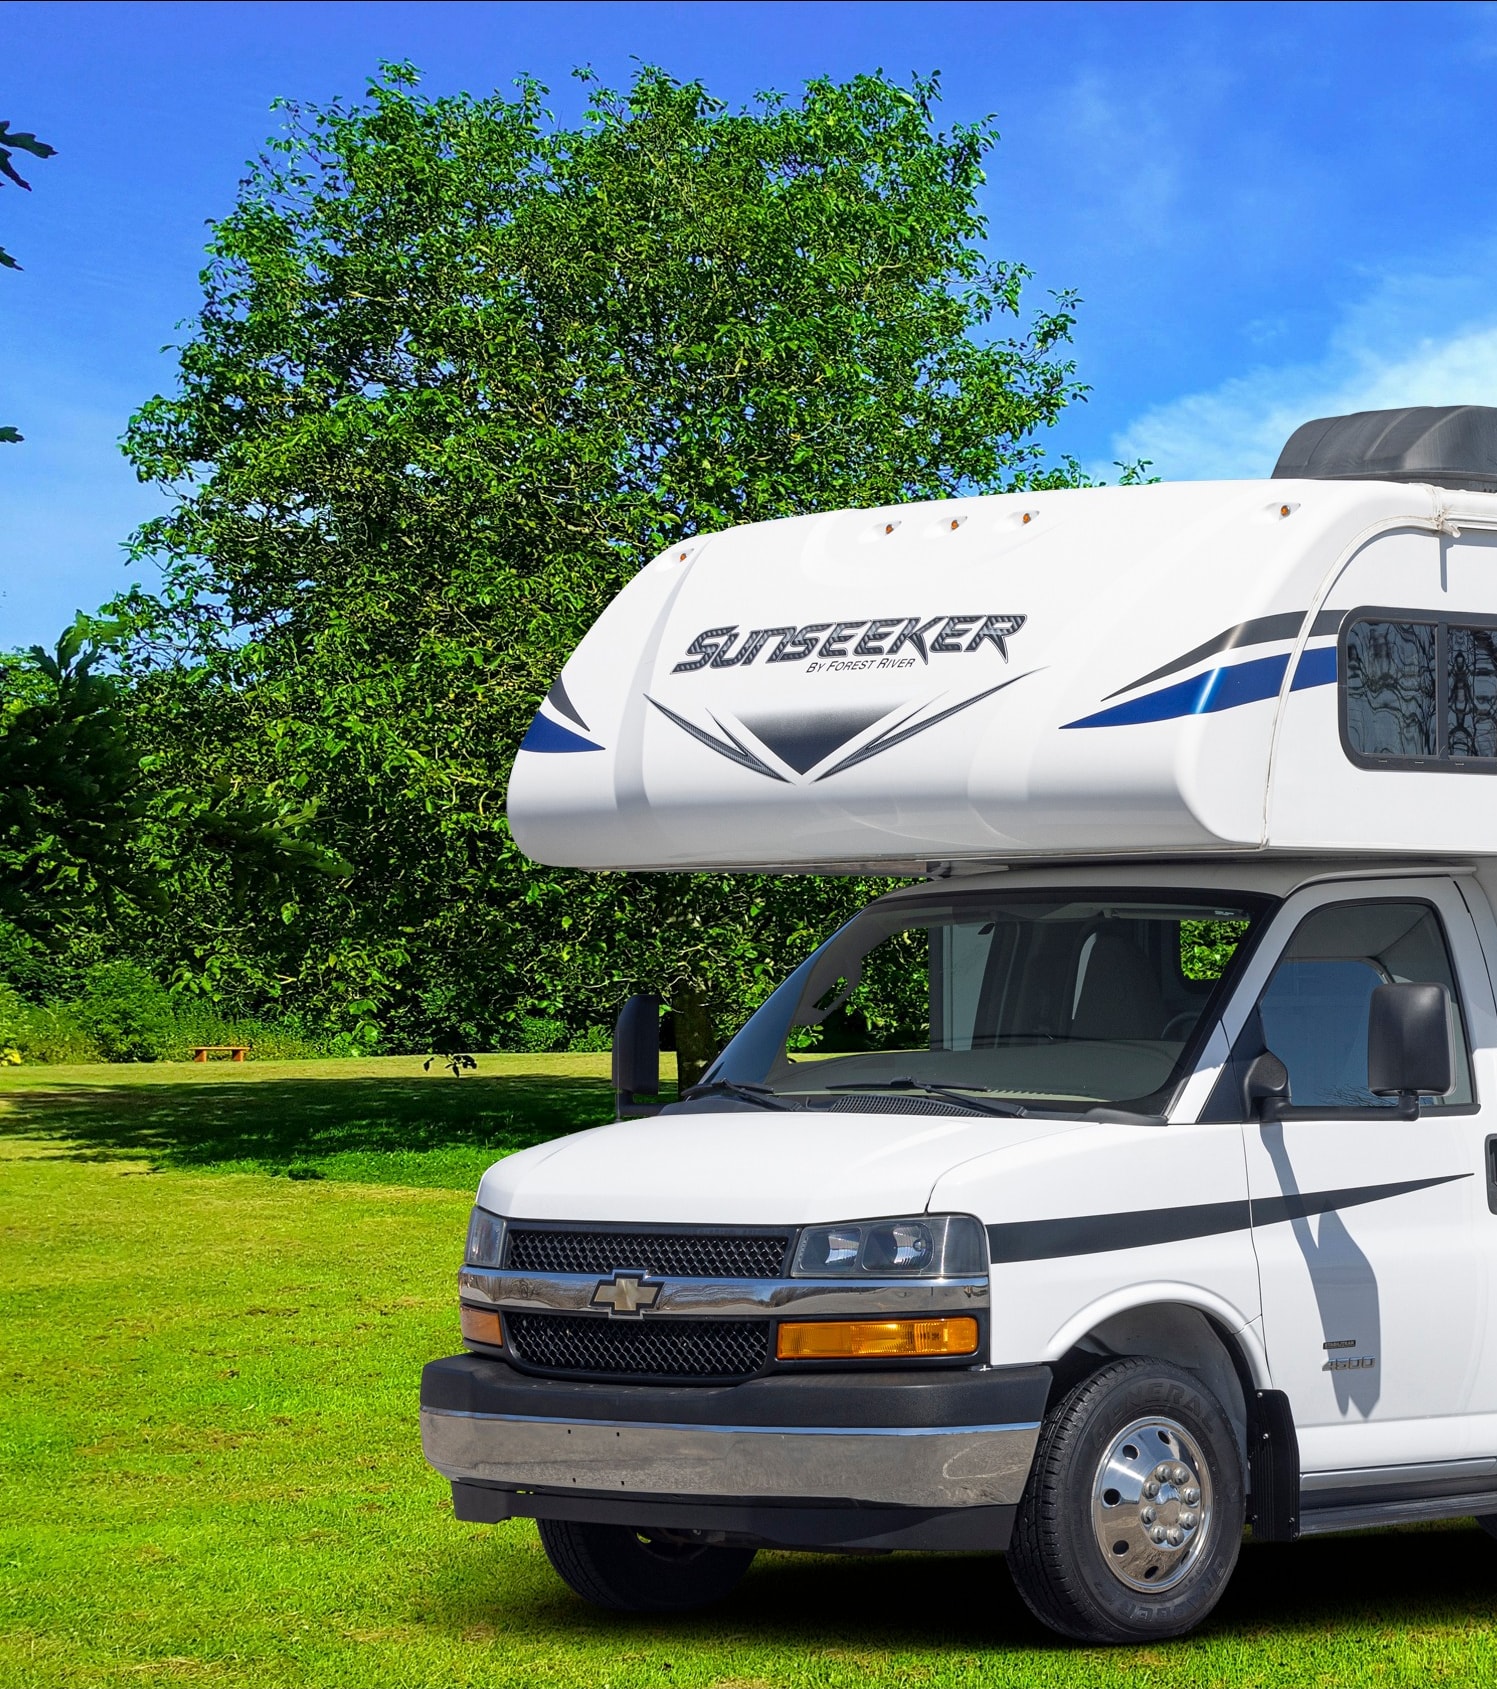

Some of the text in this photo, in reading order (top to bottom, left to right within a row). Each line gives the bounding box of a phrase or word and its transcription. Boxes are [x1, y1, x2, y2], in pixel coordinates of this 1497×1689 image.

[669, 613, 1028, 676] SUNSEEKER
[826, 659, 877, 672] FOREST
[877, 657, 917, 669] RIVER
